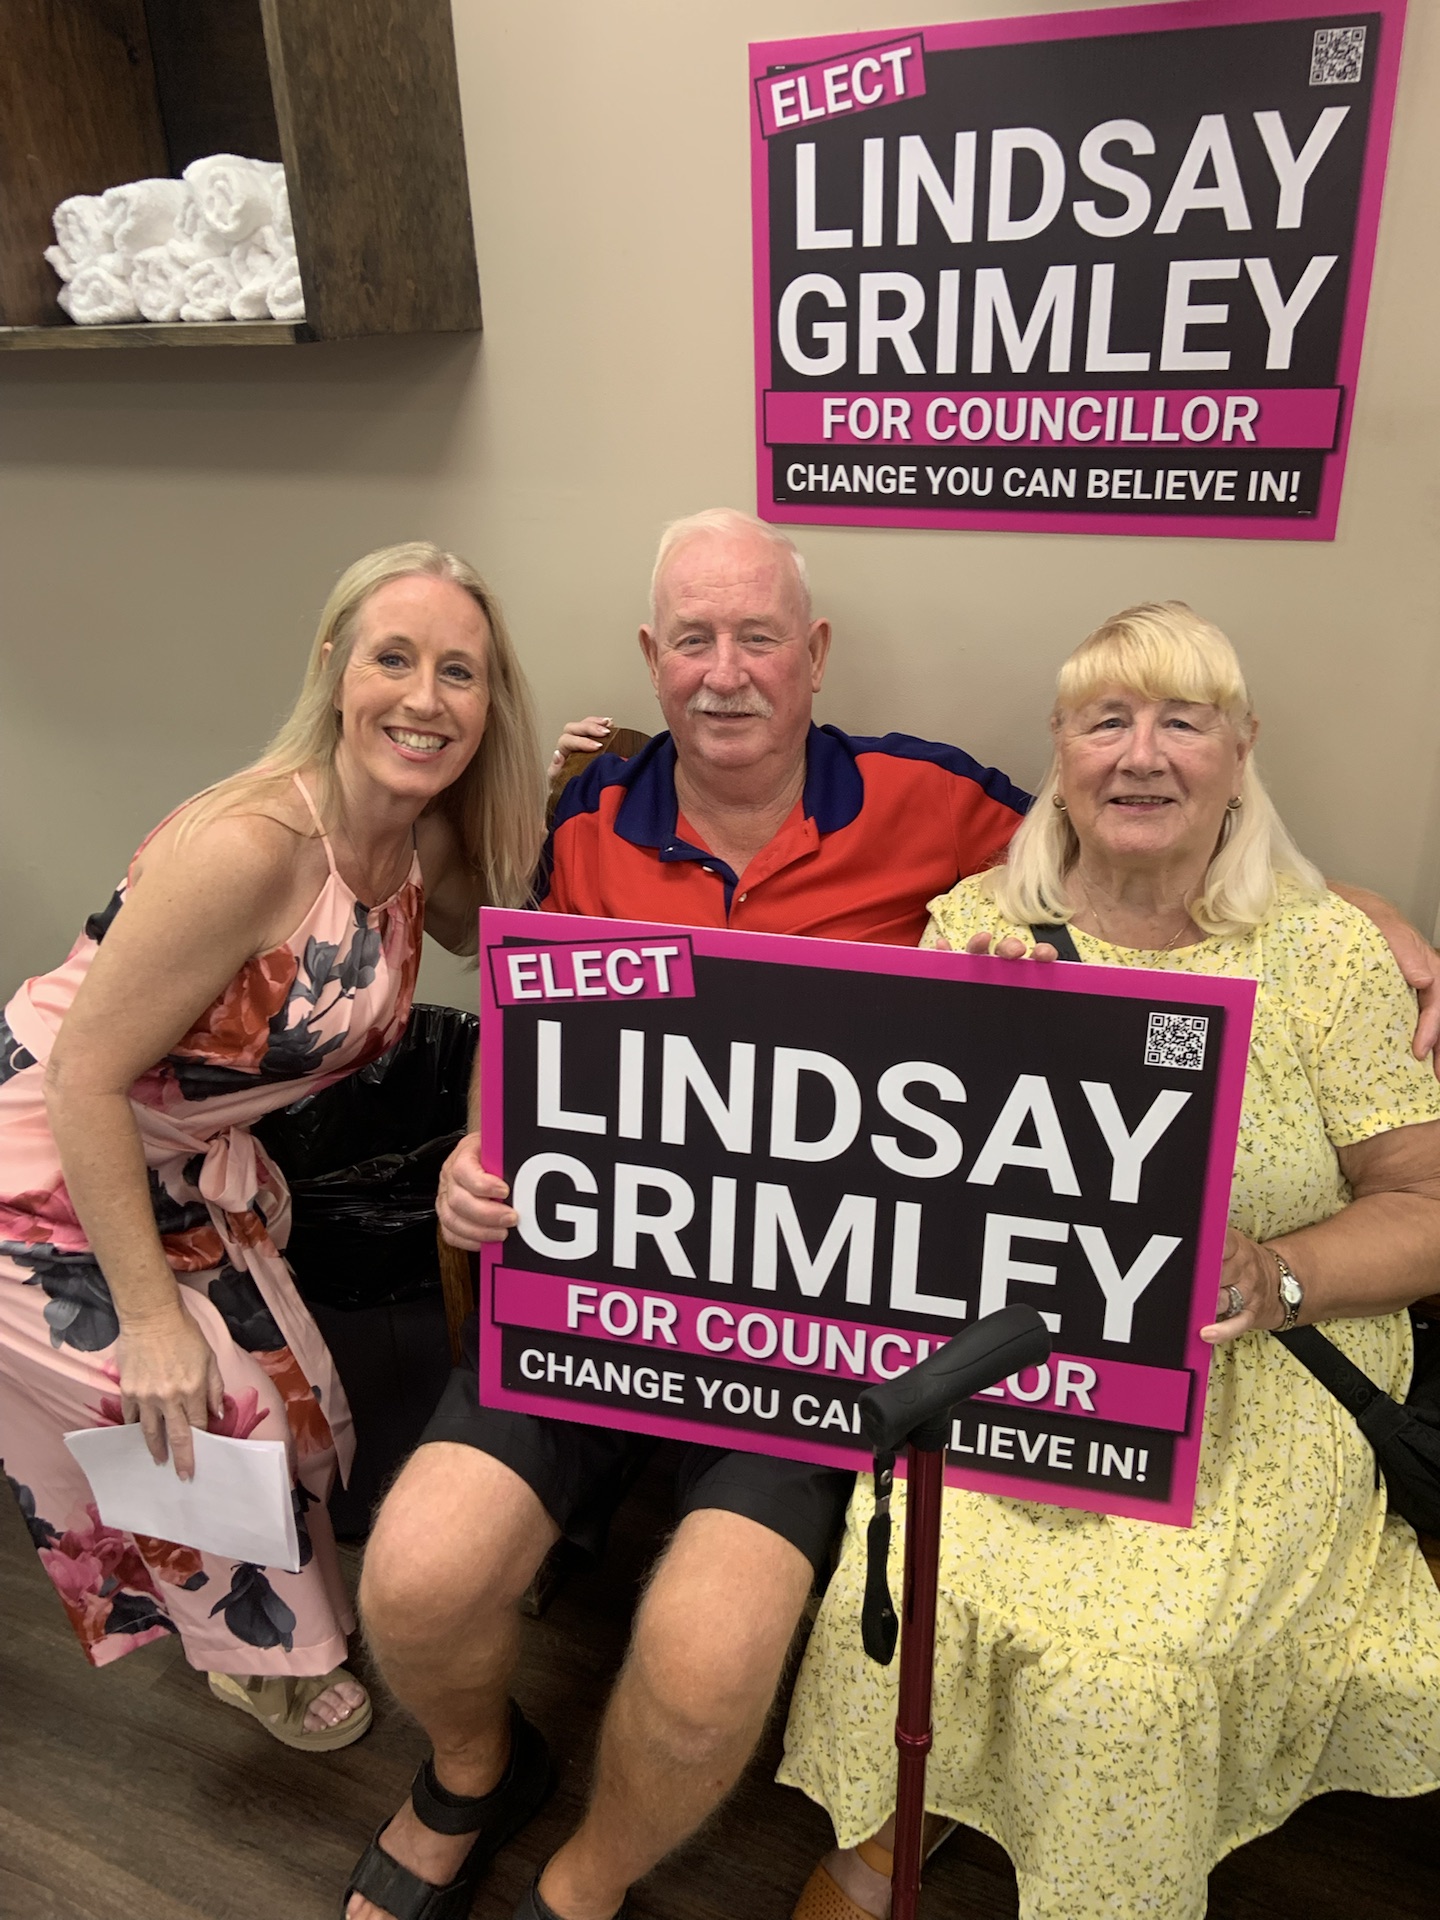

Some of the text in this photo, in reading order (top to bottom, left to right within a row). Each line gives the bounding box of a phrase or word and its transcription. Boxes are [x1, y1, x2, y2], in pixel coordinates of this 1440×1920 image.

[770, 46, 912, 128] ELECT
[796, 105, 1351, 250] LINDSAY
[778, 255, 1338, 376] GRIMLEY
[823, 396, 1259, 442] FOR COUNCILLOR
[786, 463, 1301, 503] CHANGE YOU CAN BELIEVE IN!
[507, 946, 678, 999] ELECT
[537, 1019, 1193, 1204] LINDSAY
[512, 1152, 1183, 1344] GRIMLEY
[567, 1284, 1096, 1411] FOR COUNCOR
[520, 1349, 685, 1404] CHANGE
[695, 1376, 780, 1419] YOU
[950, 1419, 1075, 1470] LIEVE
[1087, 1441, 1148, 1482] IN!
